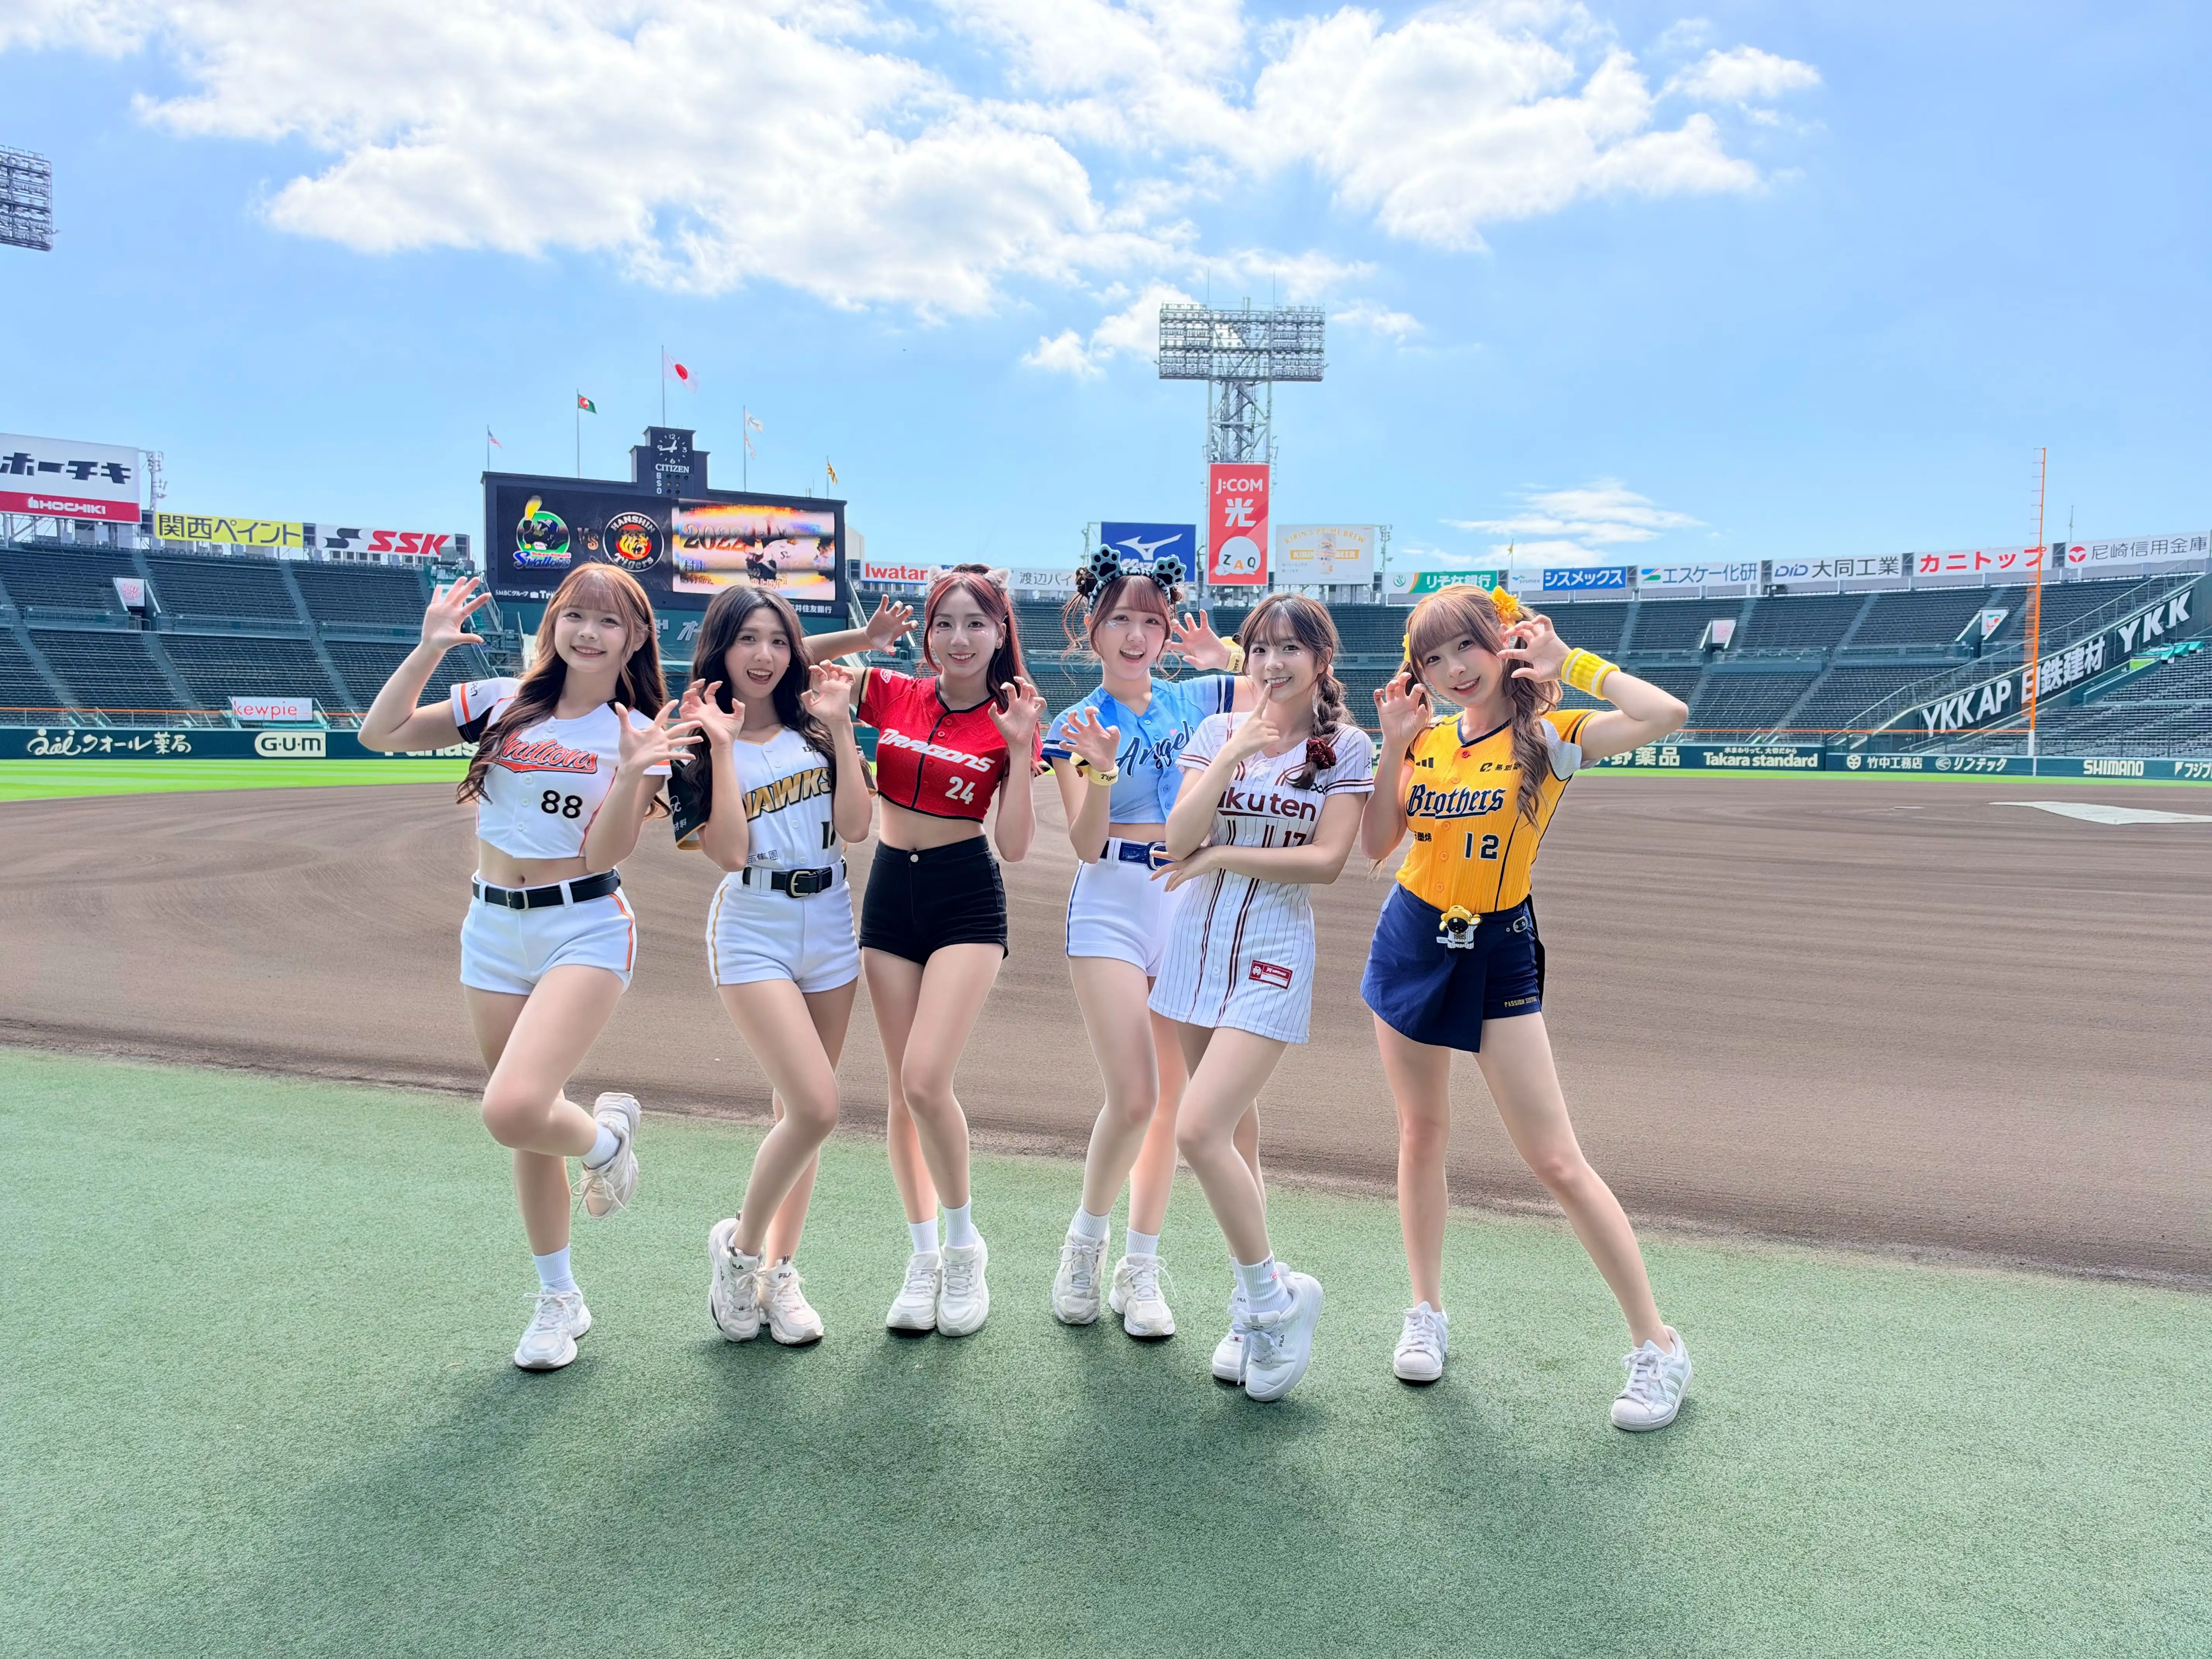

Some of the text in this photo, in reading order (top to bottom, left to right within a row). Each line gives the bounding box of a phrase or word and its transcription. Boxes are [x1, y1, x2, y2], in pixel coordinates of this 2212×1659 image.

[0, 452, 131, 484] ホーチキ
[655, 464, 690, 473] CITIZEN
[1216, 479, 1263, 495] J:COM
[39, 500, 106, 515] HOCHIKI
[1225, 498, 1256, 527] 光
[158, 514, 301, 545] 関西ペイント
[610, 515, 656, 533] HANSHIN
[367, 530, 450, 555] SSK
[683, 523, 746, 551] 2022
[1284, 529, 1313, 544] KIRIN'S
[1344, 530, 1365, 543] BREW
[2091, 536, 2208, 560] 尼崎信用金庫
[614, 553, 654, 569] Tigers
[1812, 556, 1899, 578] 大同工業
[1919, 546, 2047, 574] カニトップ
[1020, 572, 1076, 586] 渡辺パイ
[1426, 574, 1491, 589] りそな銀行
[1545, 568, 1624, 587] シスメックス
[1662, 563, 1758, 584] エスケー化研
[2118, 591, 2191, 653] YKK
[2021, 636, 2106, 704] 日鉄建材
[234, 700, 297, 720] kewpie
[82, 731, 192, 754] クオール薬局
[1703, 752, 1818, 768] Takara standard
[1867, 756, 1923, 769] 竹中工務店
[1953, 757, 2007, 771] リンテック
[2083, 760, 2144, 776] SHIMANO
[945, 776, 976, 805] 24
[541, 790, 583, 819] 88
[1406, 783, 1506, 819] Brothers
[1283, 831, 1307, 847] 17
[1464, 831, 1500, 860] 12
[1504, 999, 1525, 1008] PASSION
